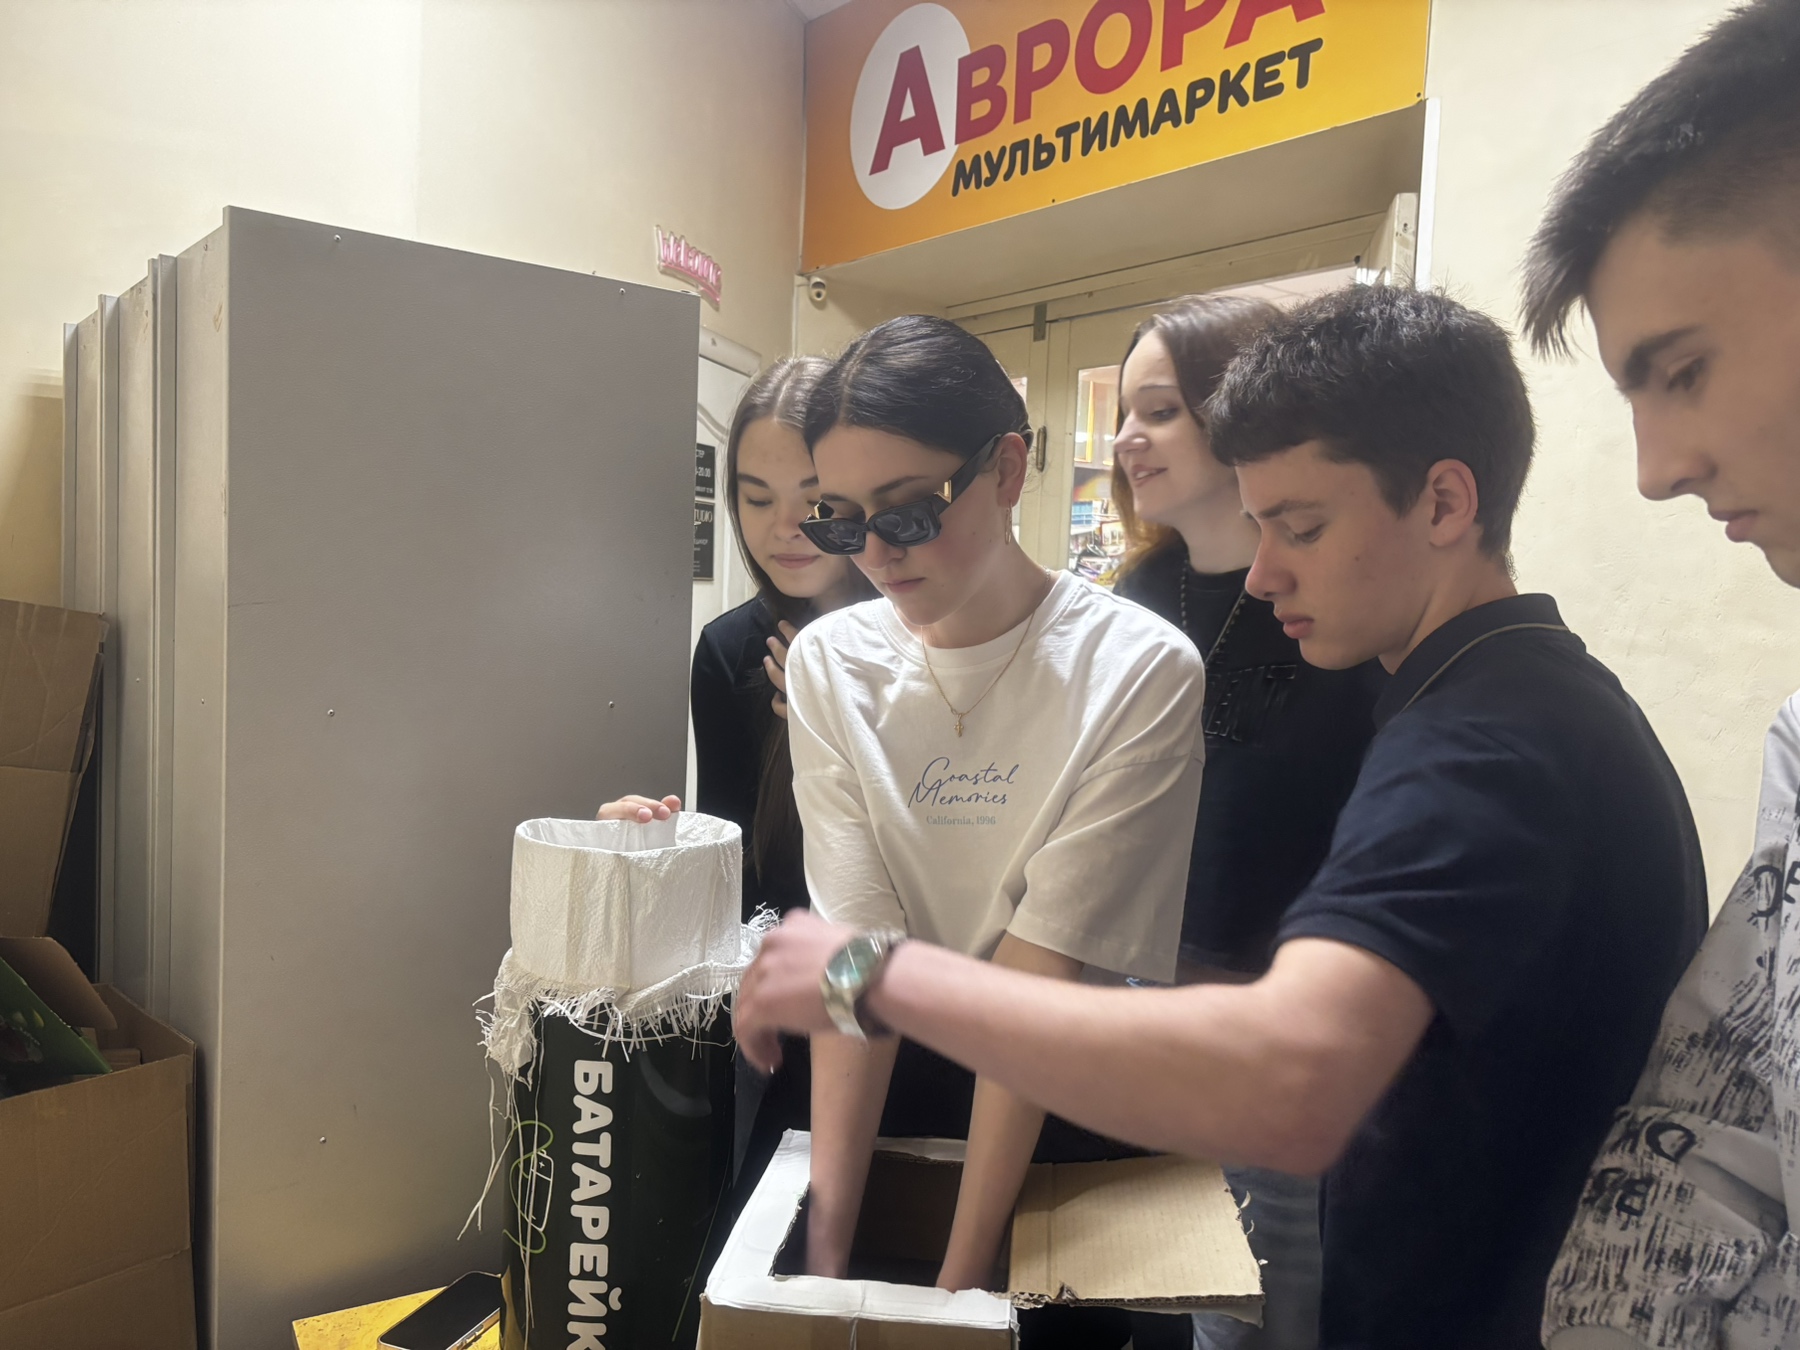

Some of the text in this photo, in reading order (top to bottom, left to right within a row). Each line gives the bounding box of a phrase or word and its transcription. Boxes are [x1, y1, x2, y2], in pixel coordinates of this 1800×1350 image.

[951, 37, 1324, 198] МУЛЬТИМАРКЕТ
[921, 756, 1020, 790] Coastal
[907, 778, 1008, 808] Memories
[926, 815, 996, 826] California, 1996
[566, 1059, 623, 1350] БАТАРЕЙК
